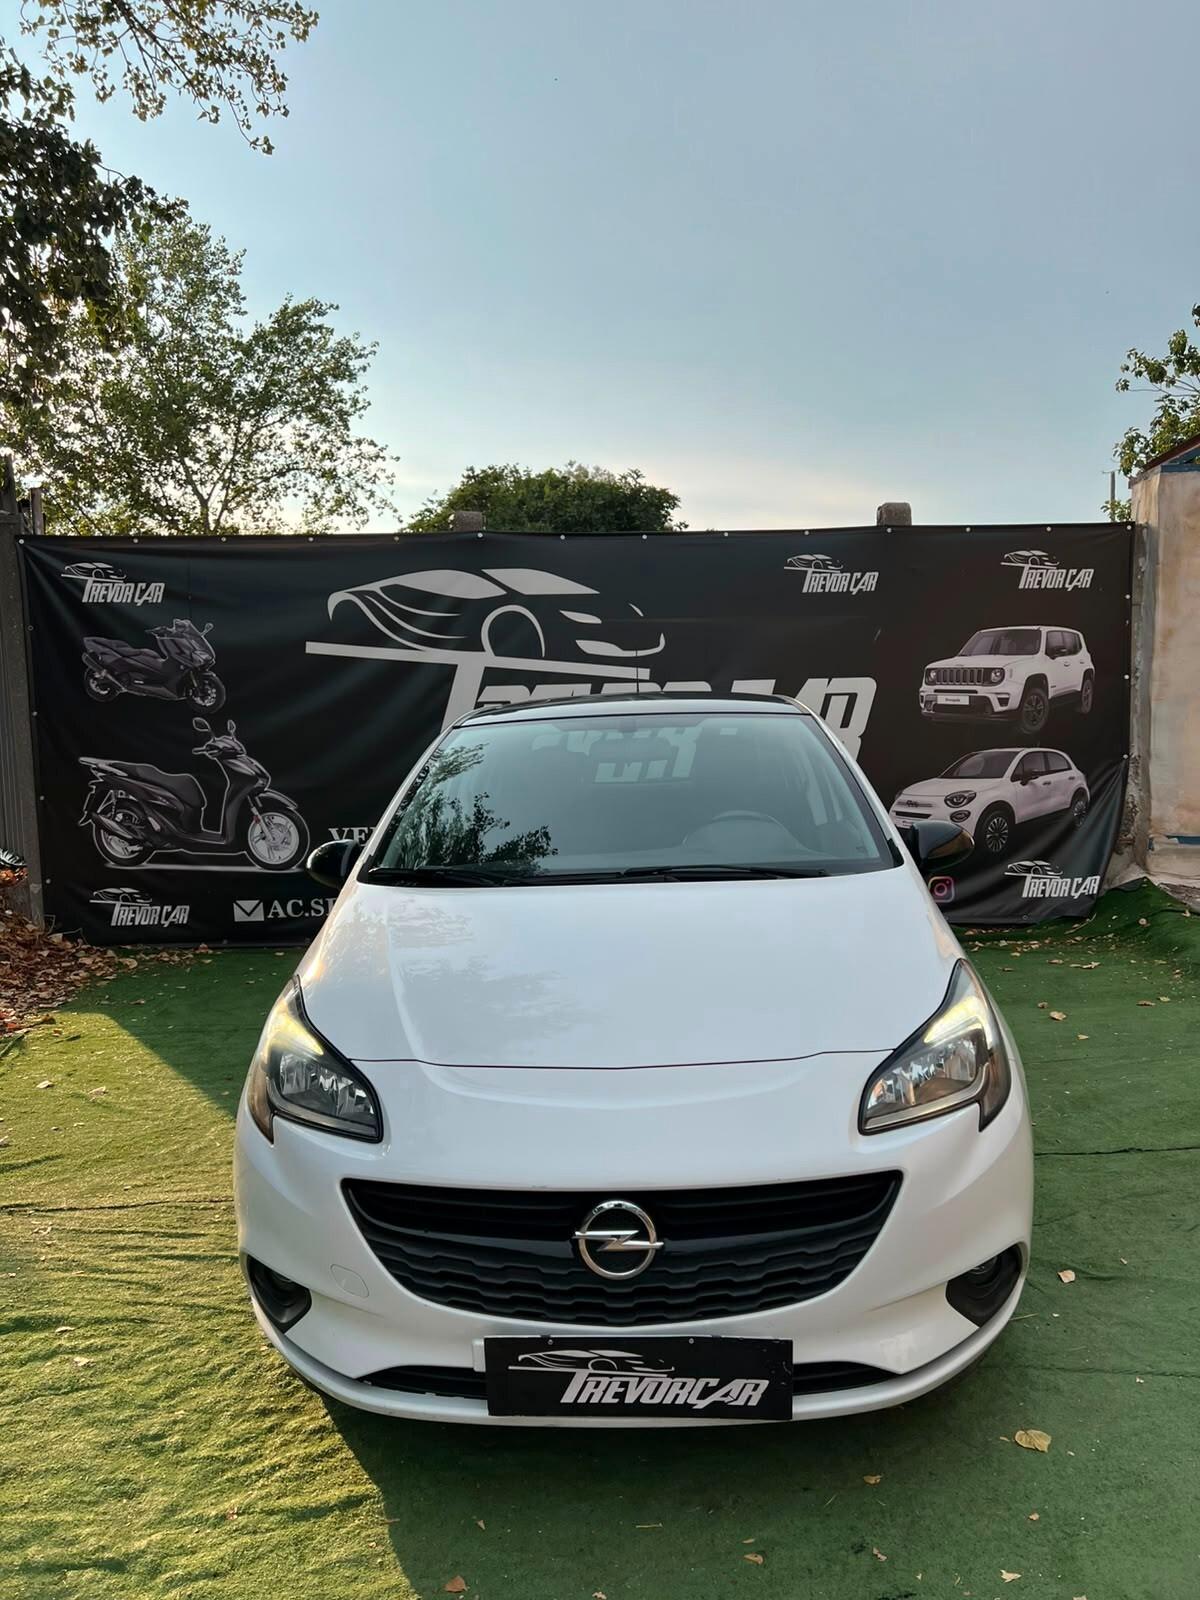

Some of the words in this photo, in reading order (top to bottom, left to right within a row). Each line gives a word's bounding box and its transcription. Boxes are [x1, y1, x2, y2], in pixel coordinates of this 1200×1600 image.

[802, 570, 851, 593] TREVOR
[849, 572, 879, 595] CAR
[1018, 565, 1066, 589] TREVOR
[1065, 568, 1094, 591] CAR
[82, 579, 135, 603] TREVOR
[134, 582, 165, 606] CAR
[1022, 875, 1071, 898] TREVOR
[1070, 875, 1100, 899] CAR
[110, 903, 160, 926] TREVOR
[160, 905, 190, 927] CAR
